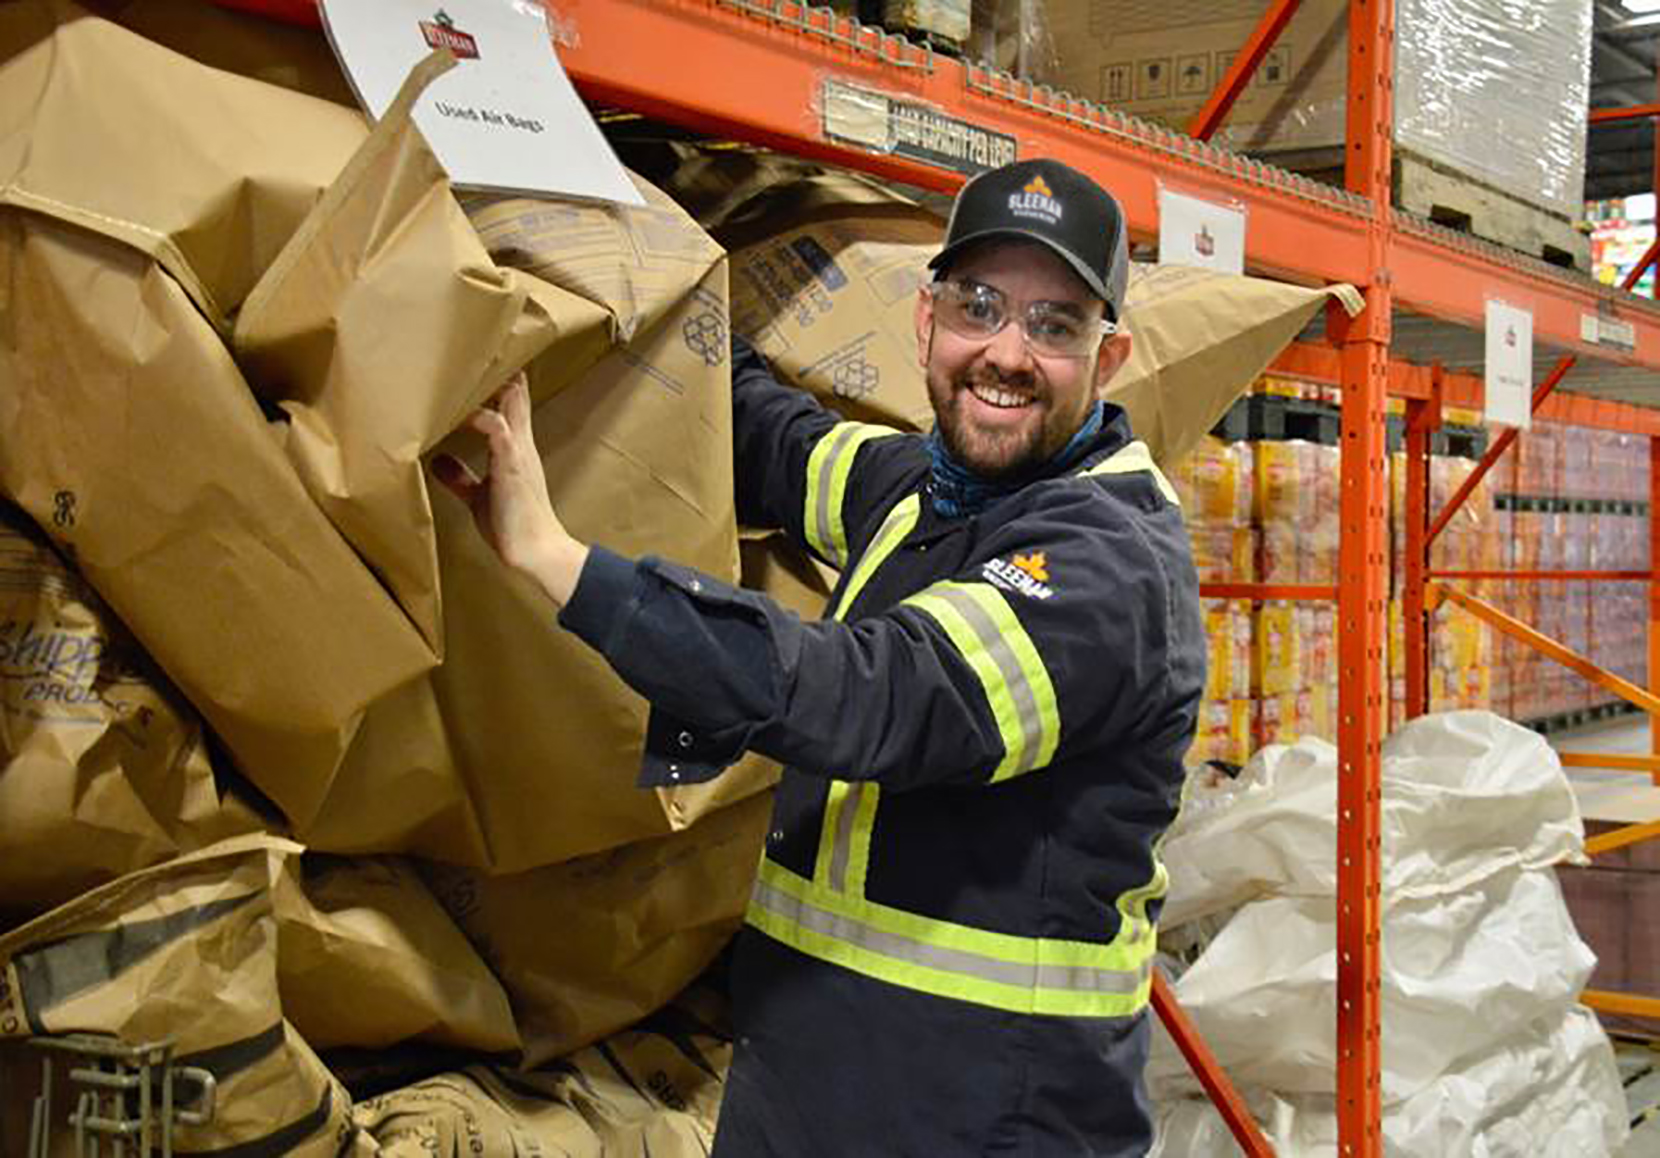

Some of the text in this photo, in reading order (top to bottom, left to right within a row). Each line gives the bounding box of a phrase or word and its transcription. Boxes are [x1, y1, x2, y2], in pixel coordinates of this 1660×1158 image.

[435, 101, 544, 133] Used Air Bags
[1008, 192, 1062, 218] SLEEMAN
[983, 558, 1053, 600] SLEEMAN
